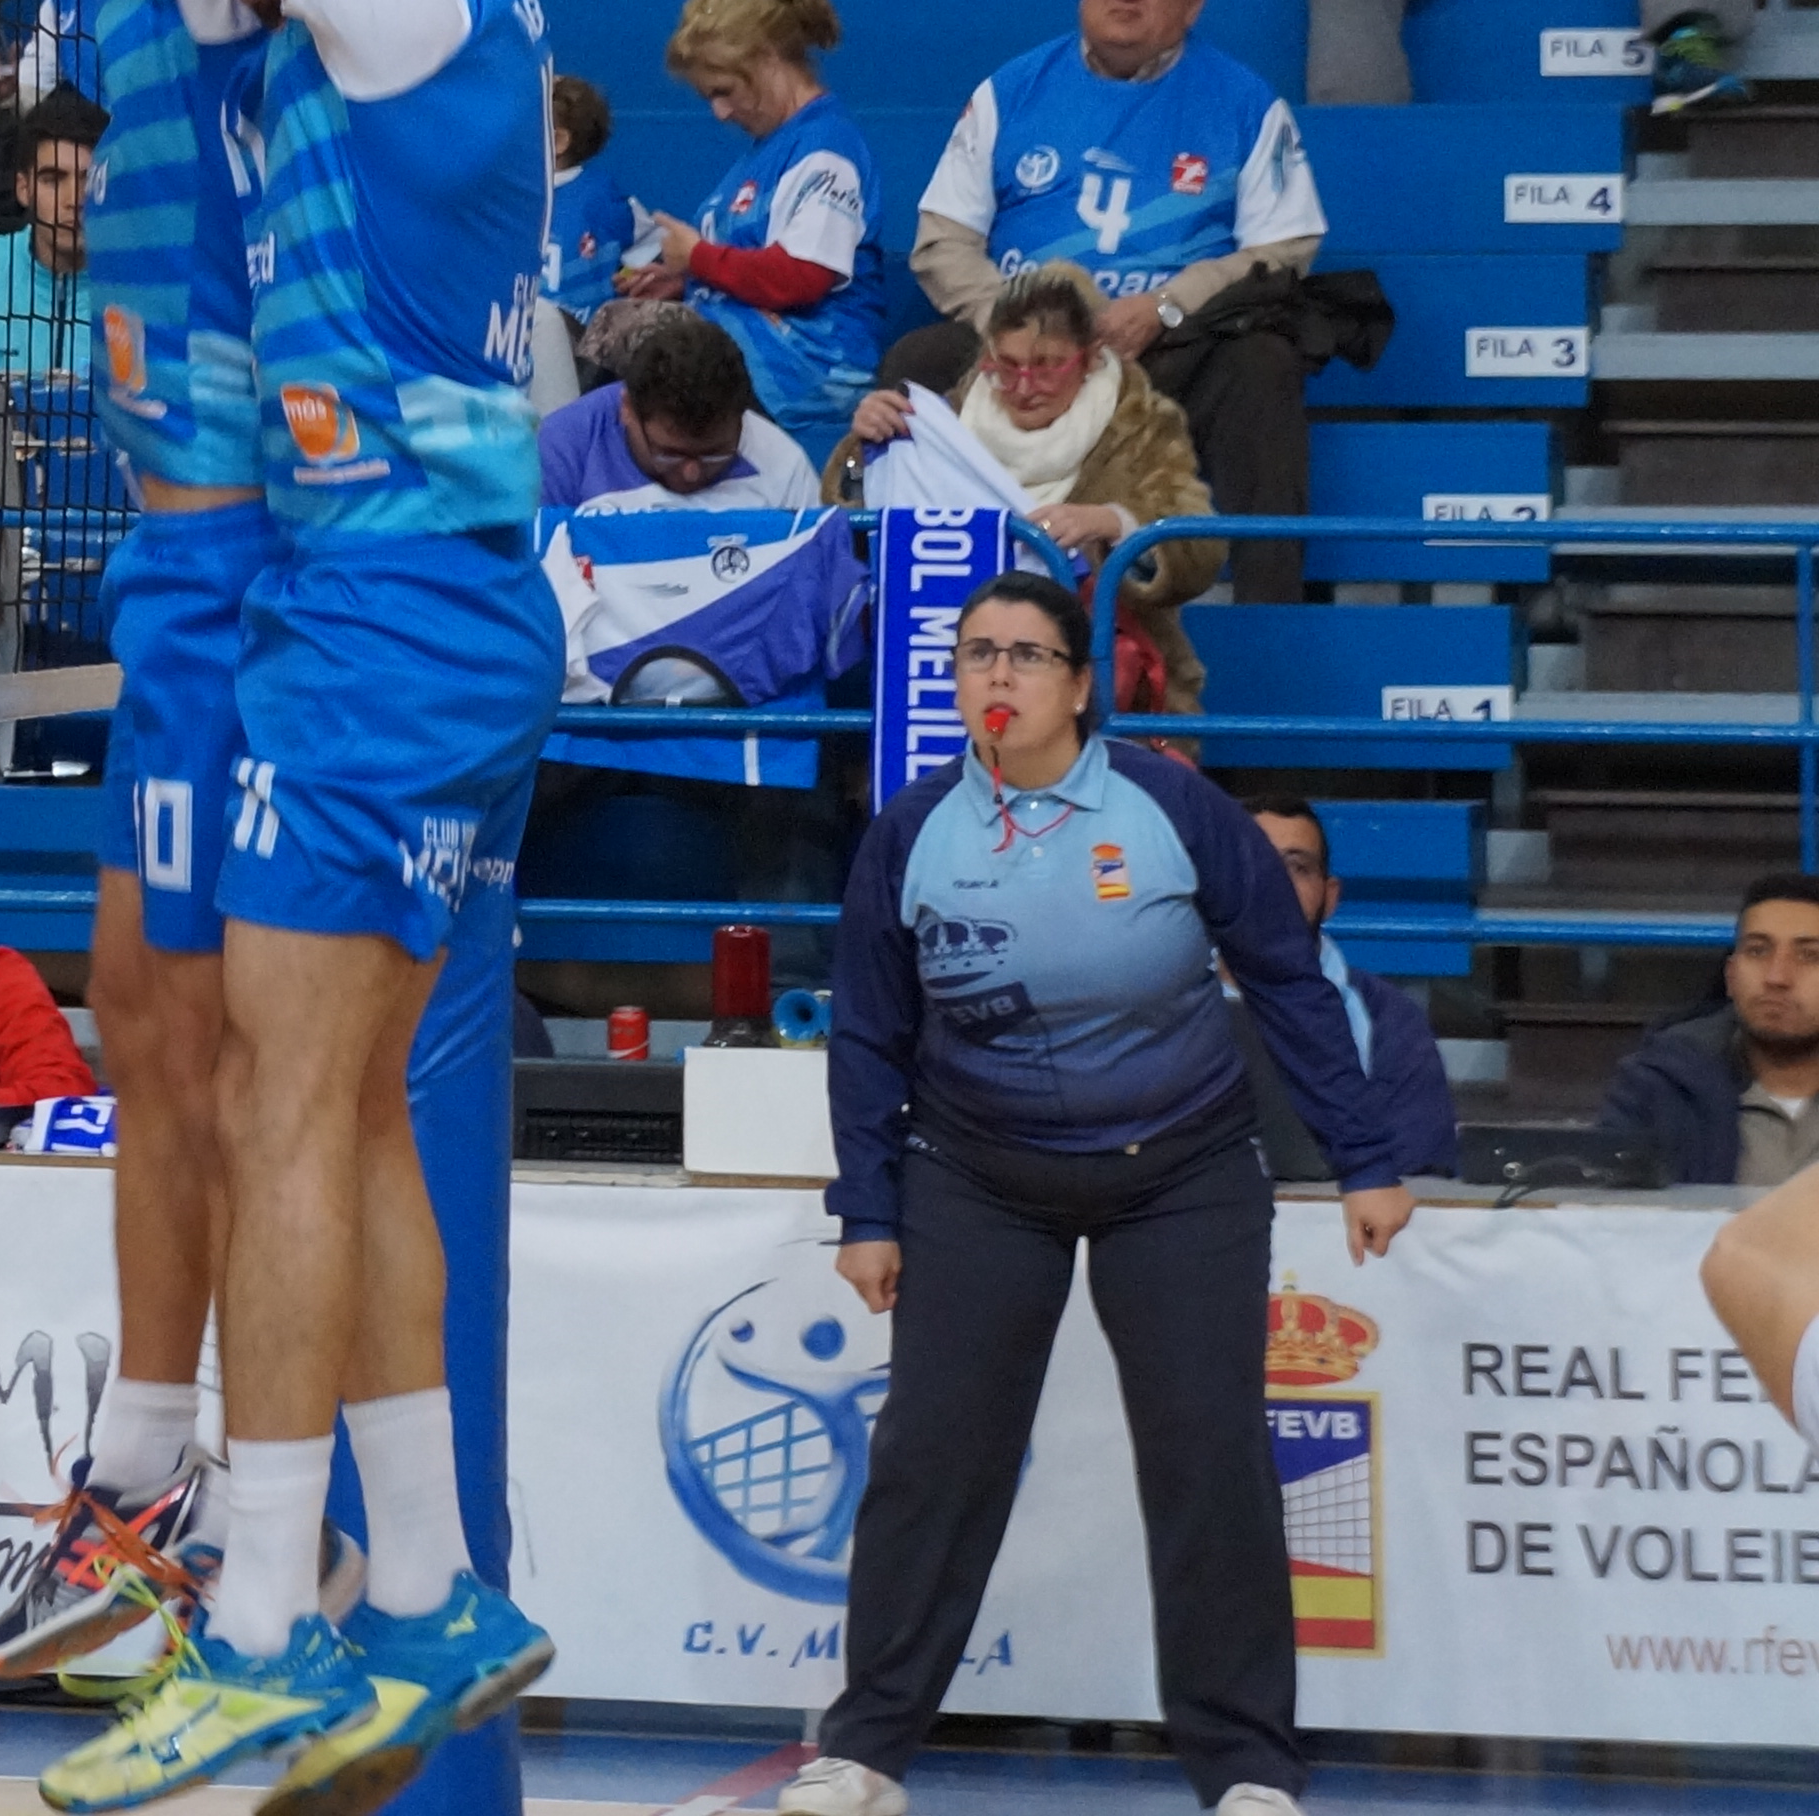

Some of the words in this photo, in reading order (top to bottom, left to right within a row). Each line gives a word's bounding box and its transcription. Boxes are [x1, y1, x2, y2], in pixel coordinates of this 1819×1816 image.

[1550, 38, 1605, 59] FILA
[1621, 38, 1646, 68] 5
[1076, 173, 1131, 255] 4
[1513, 185, 1570, 206] FILA
[1586, 186, 1612, 216] 4
[1475, 337, 1534, 359] FILA
[1551, 337, 1577, 369] 3
[1390, 697, 1453, 721] FILA
[1464, 1341, 1646, 1400] REAL
[1668, 1347, 1775, 1403] FE
[1466, 1521, 1554, 1576] DE
[682, 1621, 779, 1656] C.V.
